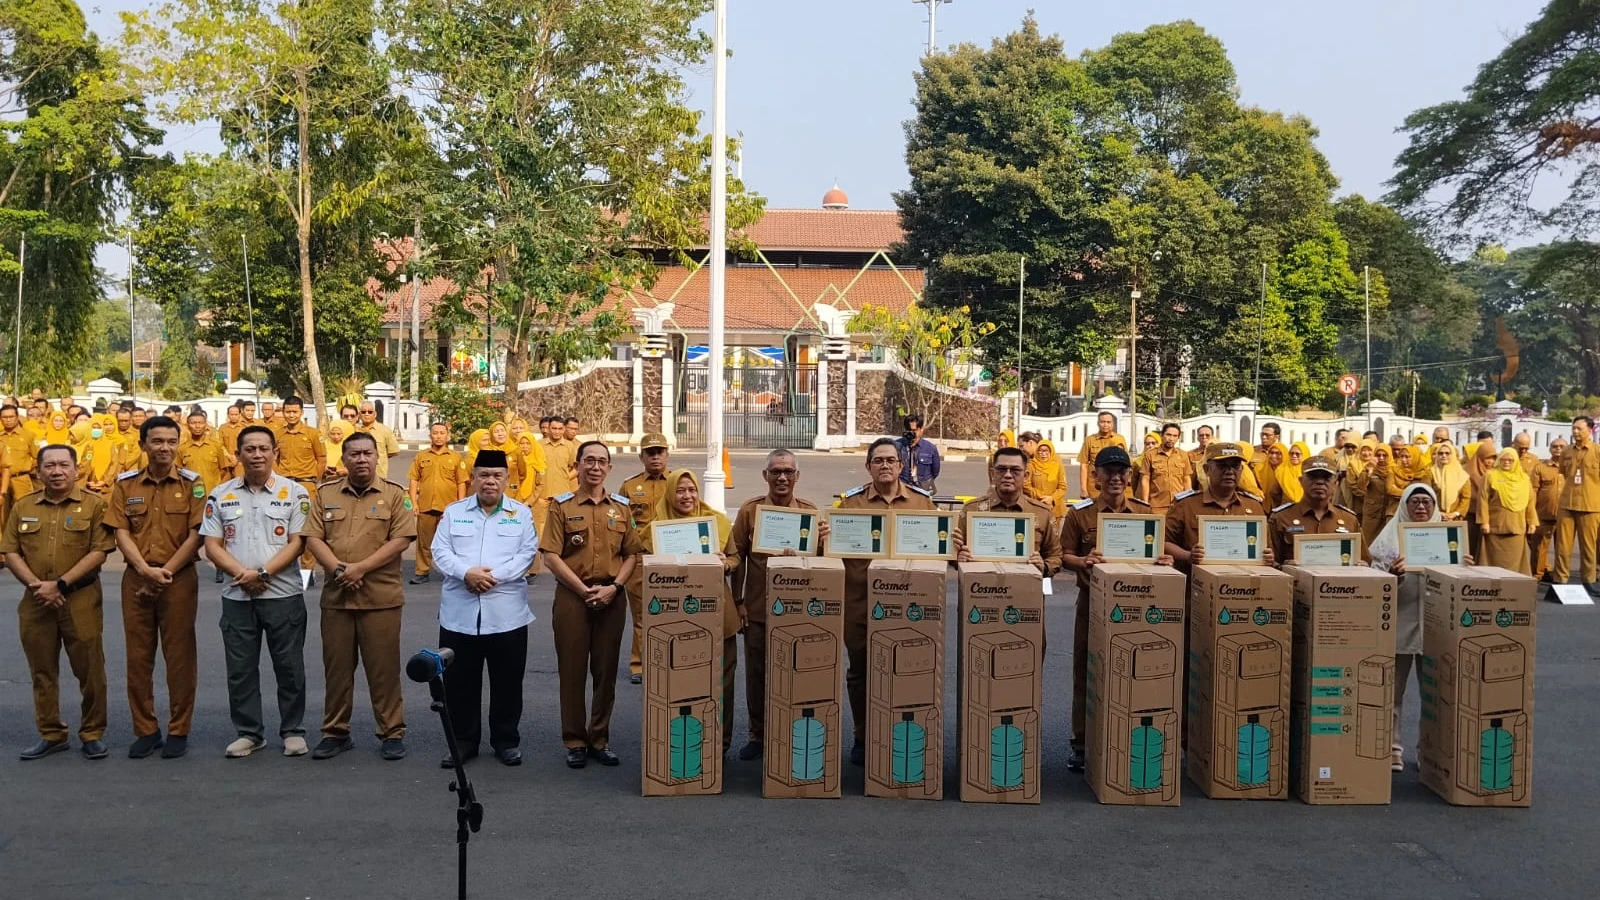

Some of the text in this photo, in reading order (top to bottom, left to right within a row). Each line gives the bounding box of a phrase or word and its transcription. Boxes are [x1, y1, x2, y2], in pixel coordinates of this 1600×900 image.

[649, 572, 686, 584] Cosmos
[773, 574, 810, 586] Cosmos
[873, 579, 909, 590] Cosmos
[971, 582, 1008, 594] Cosmos
[1113, 580, 1152, 593] Cosmos
[1220, 583, 1256, 595] Cosmos
[1320, 582, 1356, 594] Cosmos
[1461, 584, 1499, 597] Cosmos
